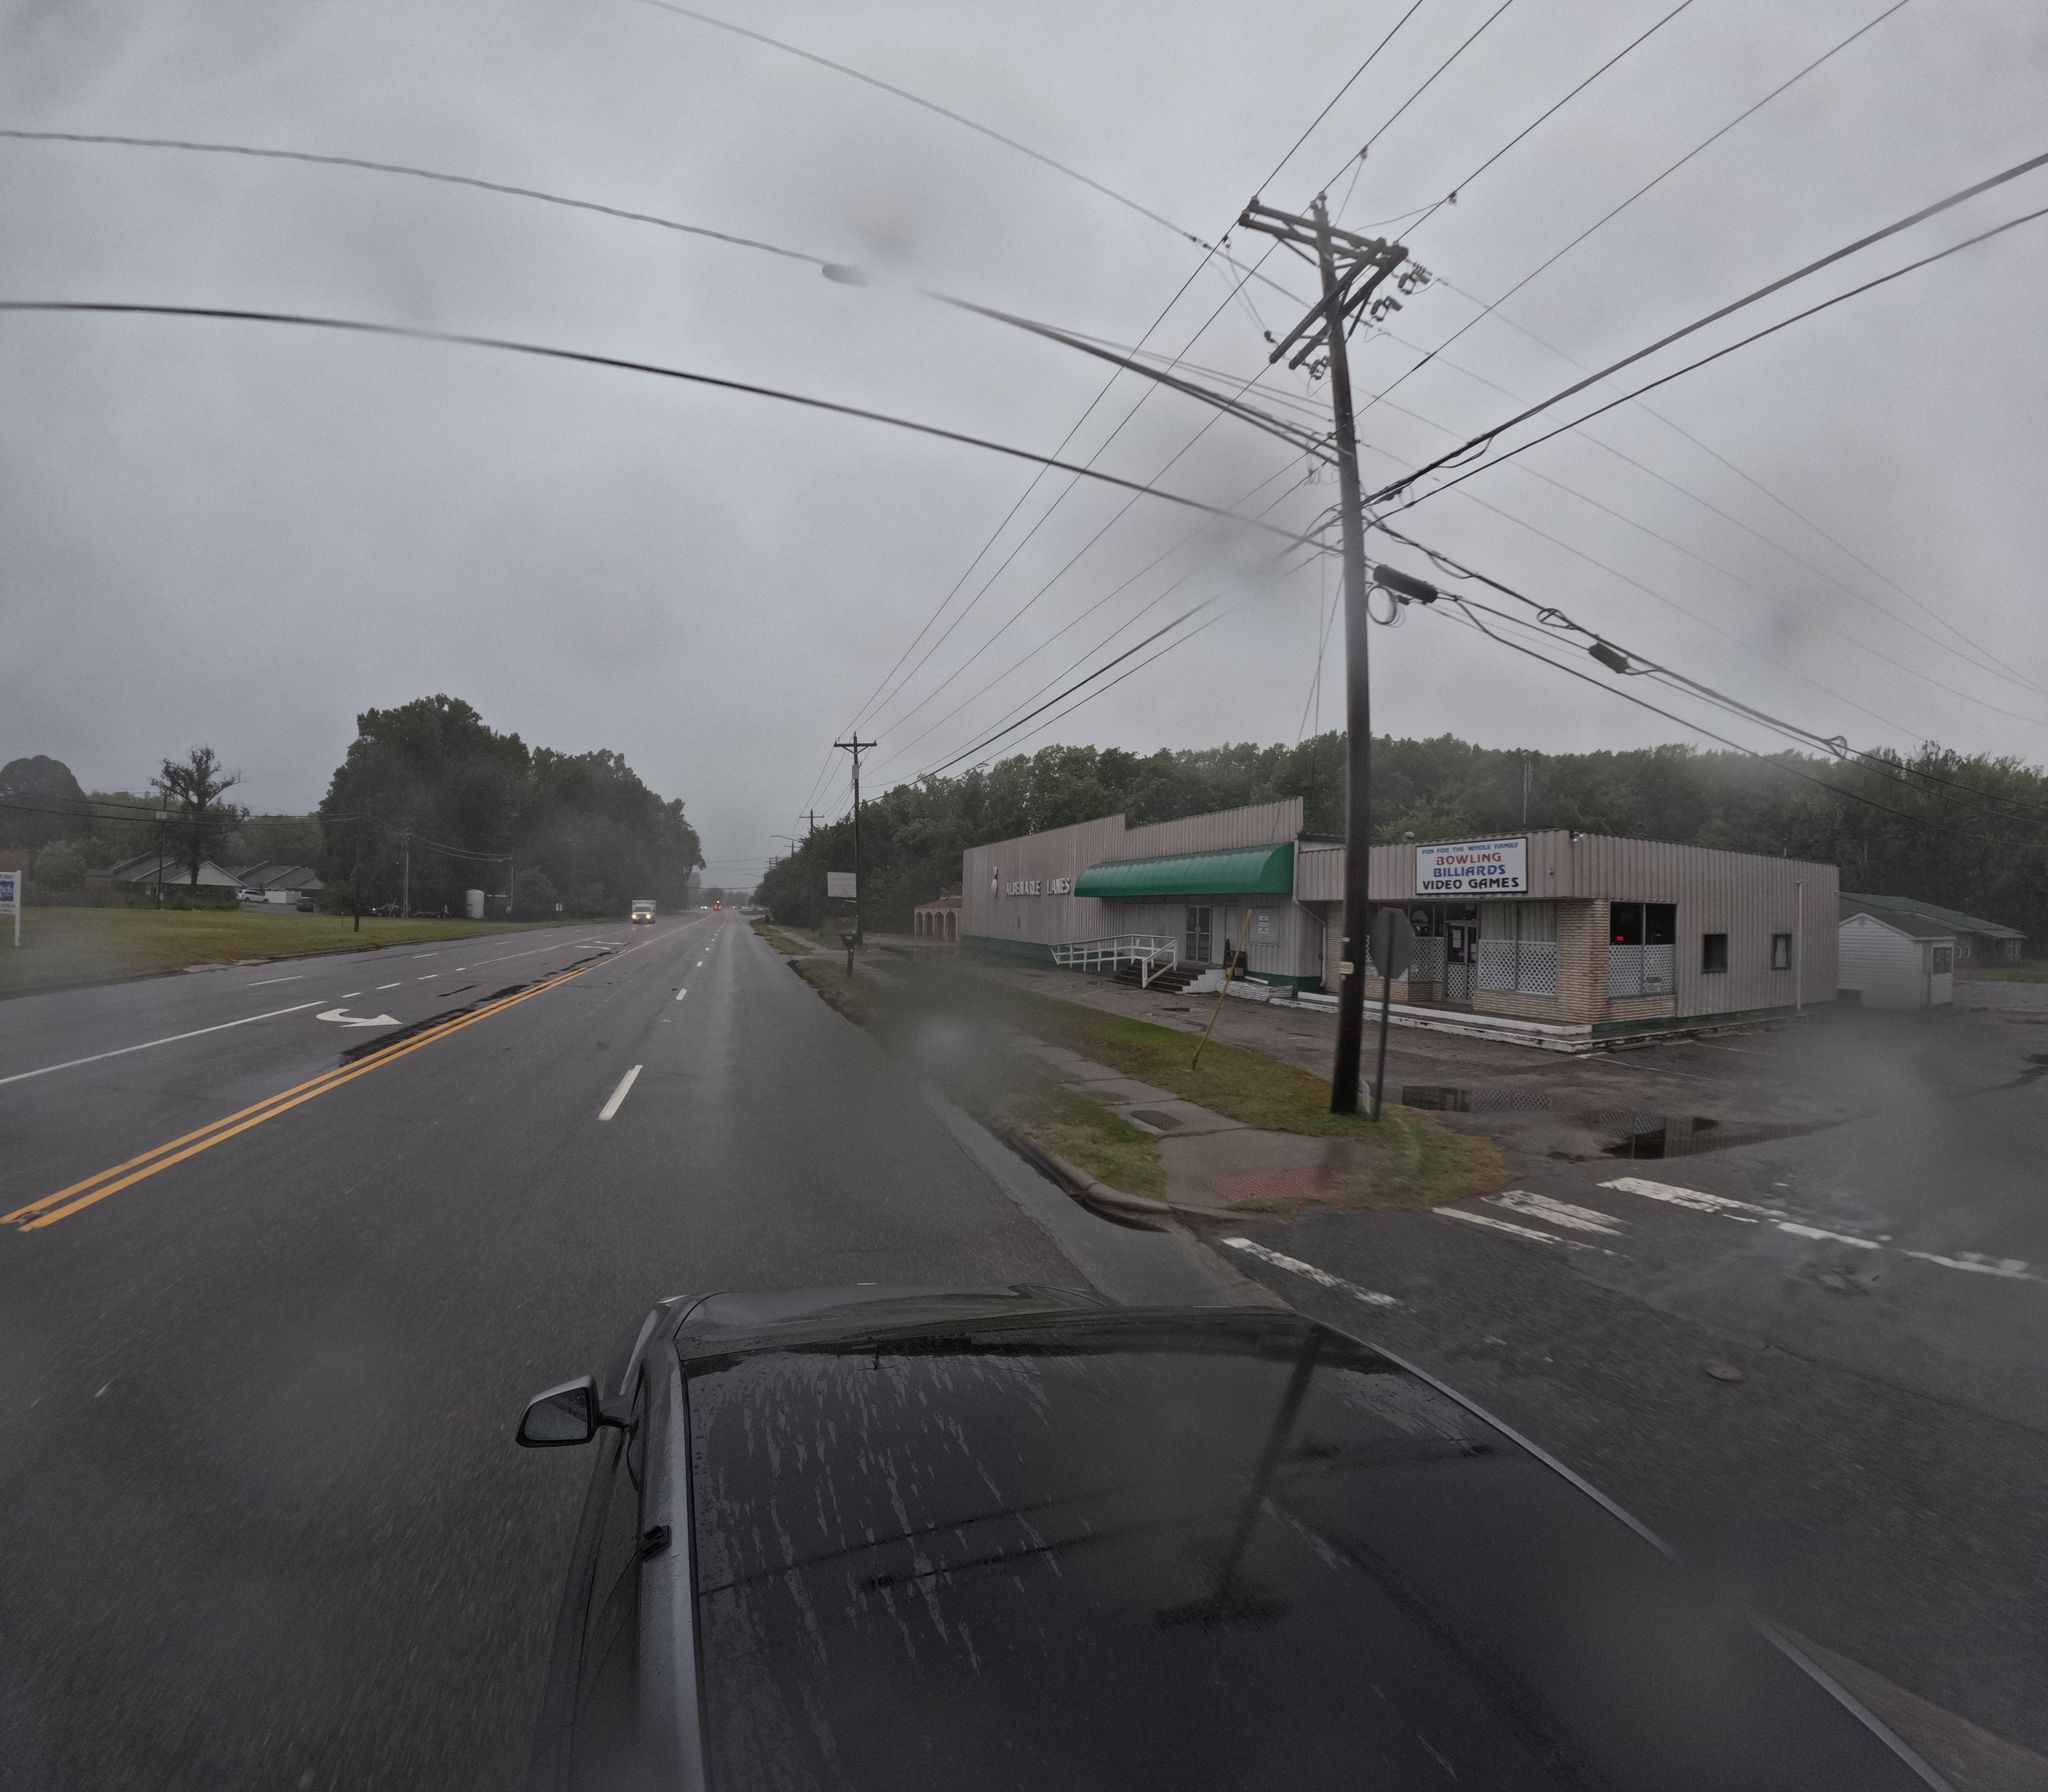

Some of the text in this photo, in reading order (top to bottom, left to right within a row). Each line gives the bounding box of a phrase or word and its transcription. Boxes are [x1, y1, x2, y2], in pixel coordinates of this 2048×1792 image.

[1494, 842, 1519, 850] FAMILY
[1436, 852, 1502, 866] BOWLING
[1433, 865, 1506, 878] BILLIARDS
[1047, 878, 1071, 895] LANES
[1422, 877, 1519, 890] VIDEO GAMES
